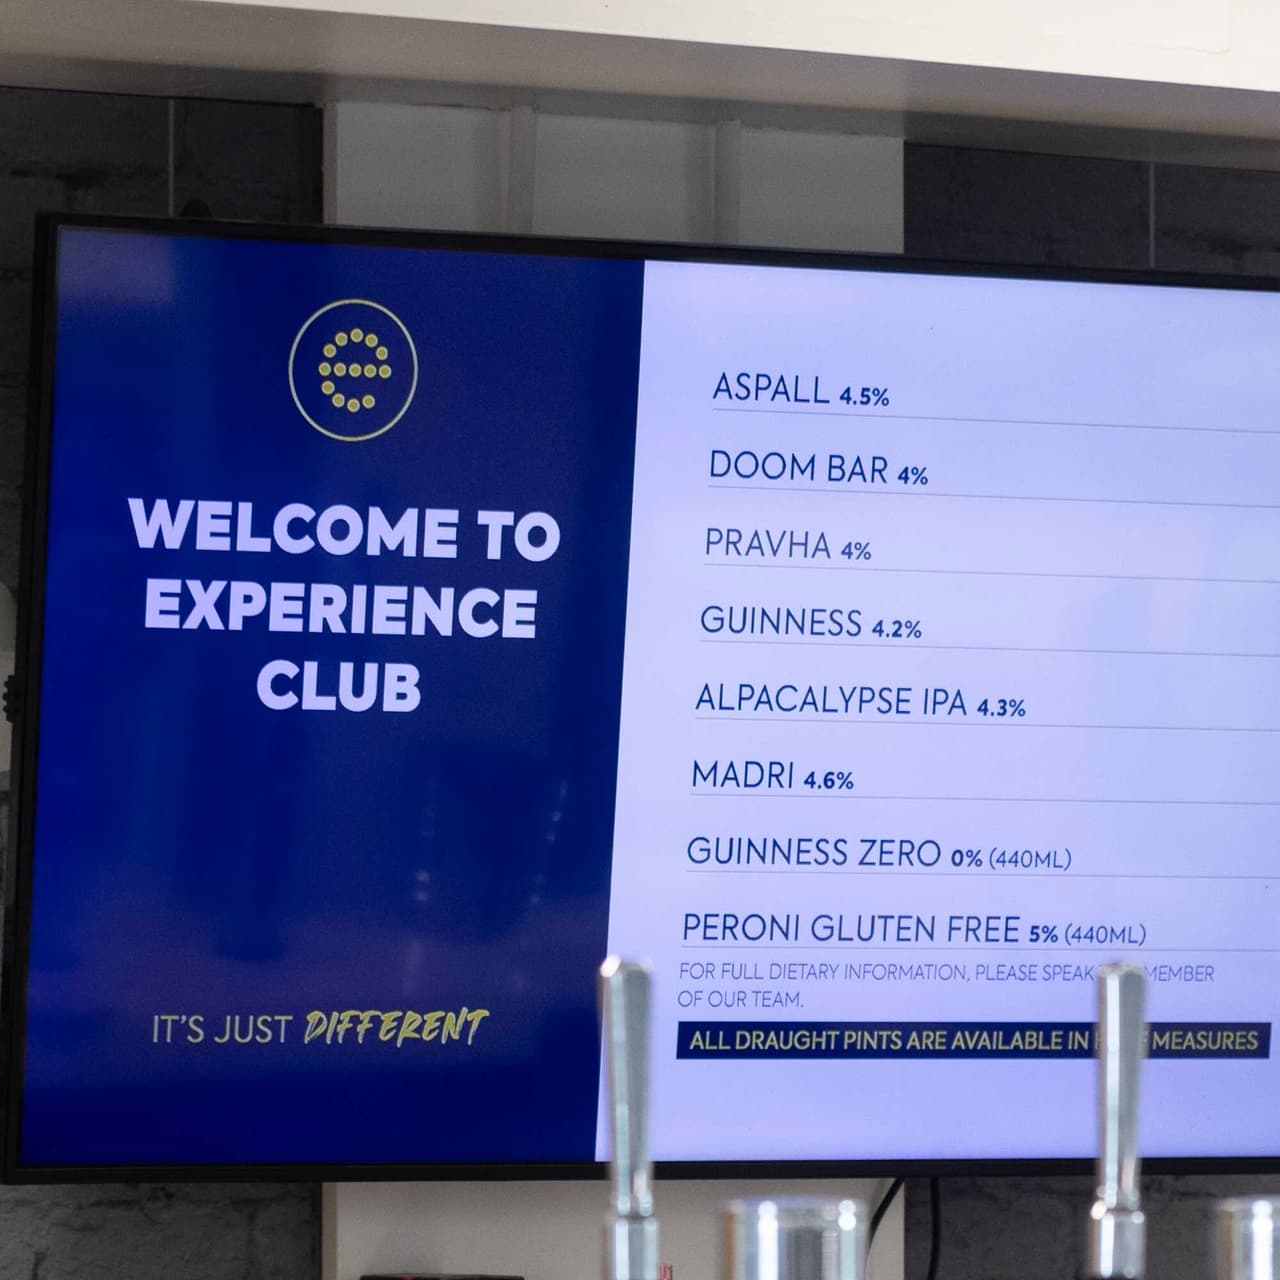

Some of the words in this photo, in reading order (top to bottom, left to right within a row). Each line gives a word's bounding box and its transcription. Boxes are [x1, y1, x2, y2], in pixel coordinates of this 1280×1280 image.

[712, 372, 830, 405] ASPALL
[839, 387, 889, 406] 4.5%
[710, 450, 815, 481] DOOM
[827, 454, 887, 484] BAR
[897, 466, 928, 485] 4%
[128, 497, 459, 559] WELCOME
[478, 510, 561, 562] TO
[705, 527, 831, 559] PRAVHA
[840, 542, 871, 560] 4%
[144, 578, 538, 639] EXPERIENCE
[700, 606, 862, 637] GUINNESS
[872, 619, 922, 639] 4.2%
[257, 659, 421, 712] CLUB
[695, 683, 912, 715] ALPACALYPSE
[923, 688, 967, 716] IPA
[976, 699, 1025, 717] 4.3%
[691, 760, 793, 789] MADRI
[803, 771, 853, 790] 4.6%
[687, 836, 848, 866] GUINNESS
[858, 839, 941, 868] ZERO
[951, 849, 982, 868] 0%
[989, 848, 1072, 872] (440ML)
[682, 913, 800, 942] PERONI
[812, 915, 935, 943] GLUTEN
[948, 915, 1020, 944] FREE
[1029, 926, 1058, 944] 5%
[1064, 923, 1146, 947] (440ML)
[680, 963, 715, 980] FOR
[722, 963, 763, 980] FULL
[769, 963, 840, 980] DIETARY
[844, 964, 970, 982] INFORMATION,
[976, 964, 1037, 981] PLEASE
[1043, 964, 1095, 981] SPEAK
[1144, 965, 1214, 982] MEMBER
[678, 991, 703, 1007] OF
[708, 991, 747, 1007] OUR
[752, 991, 804, 1008] TEAM.
[152, 1014, 205, 1044] IT'S
[214, 1014, 293, 1044] JUST
[304, 1007, 489, 1048] DIFFERENT
[690, 1031, 730, 1050] ALL
[735, 1031, 840, 1050] DRAUGHT
[843, 1031, 902, 1050] PINTS
[907, 1031, 947, 1050] ARE
[951, 1031, 1063, 1050] AVAILABLE
[1068, 1031, 1089, 1050] IN
[1153, 1031, 1259, 1050] MEASURES
